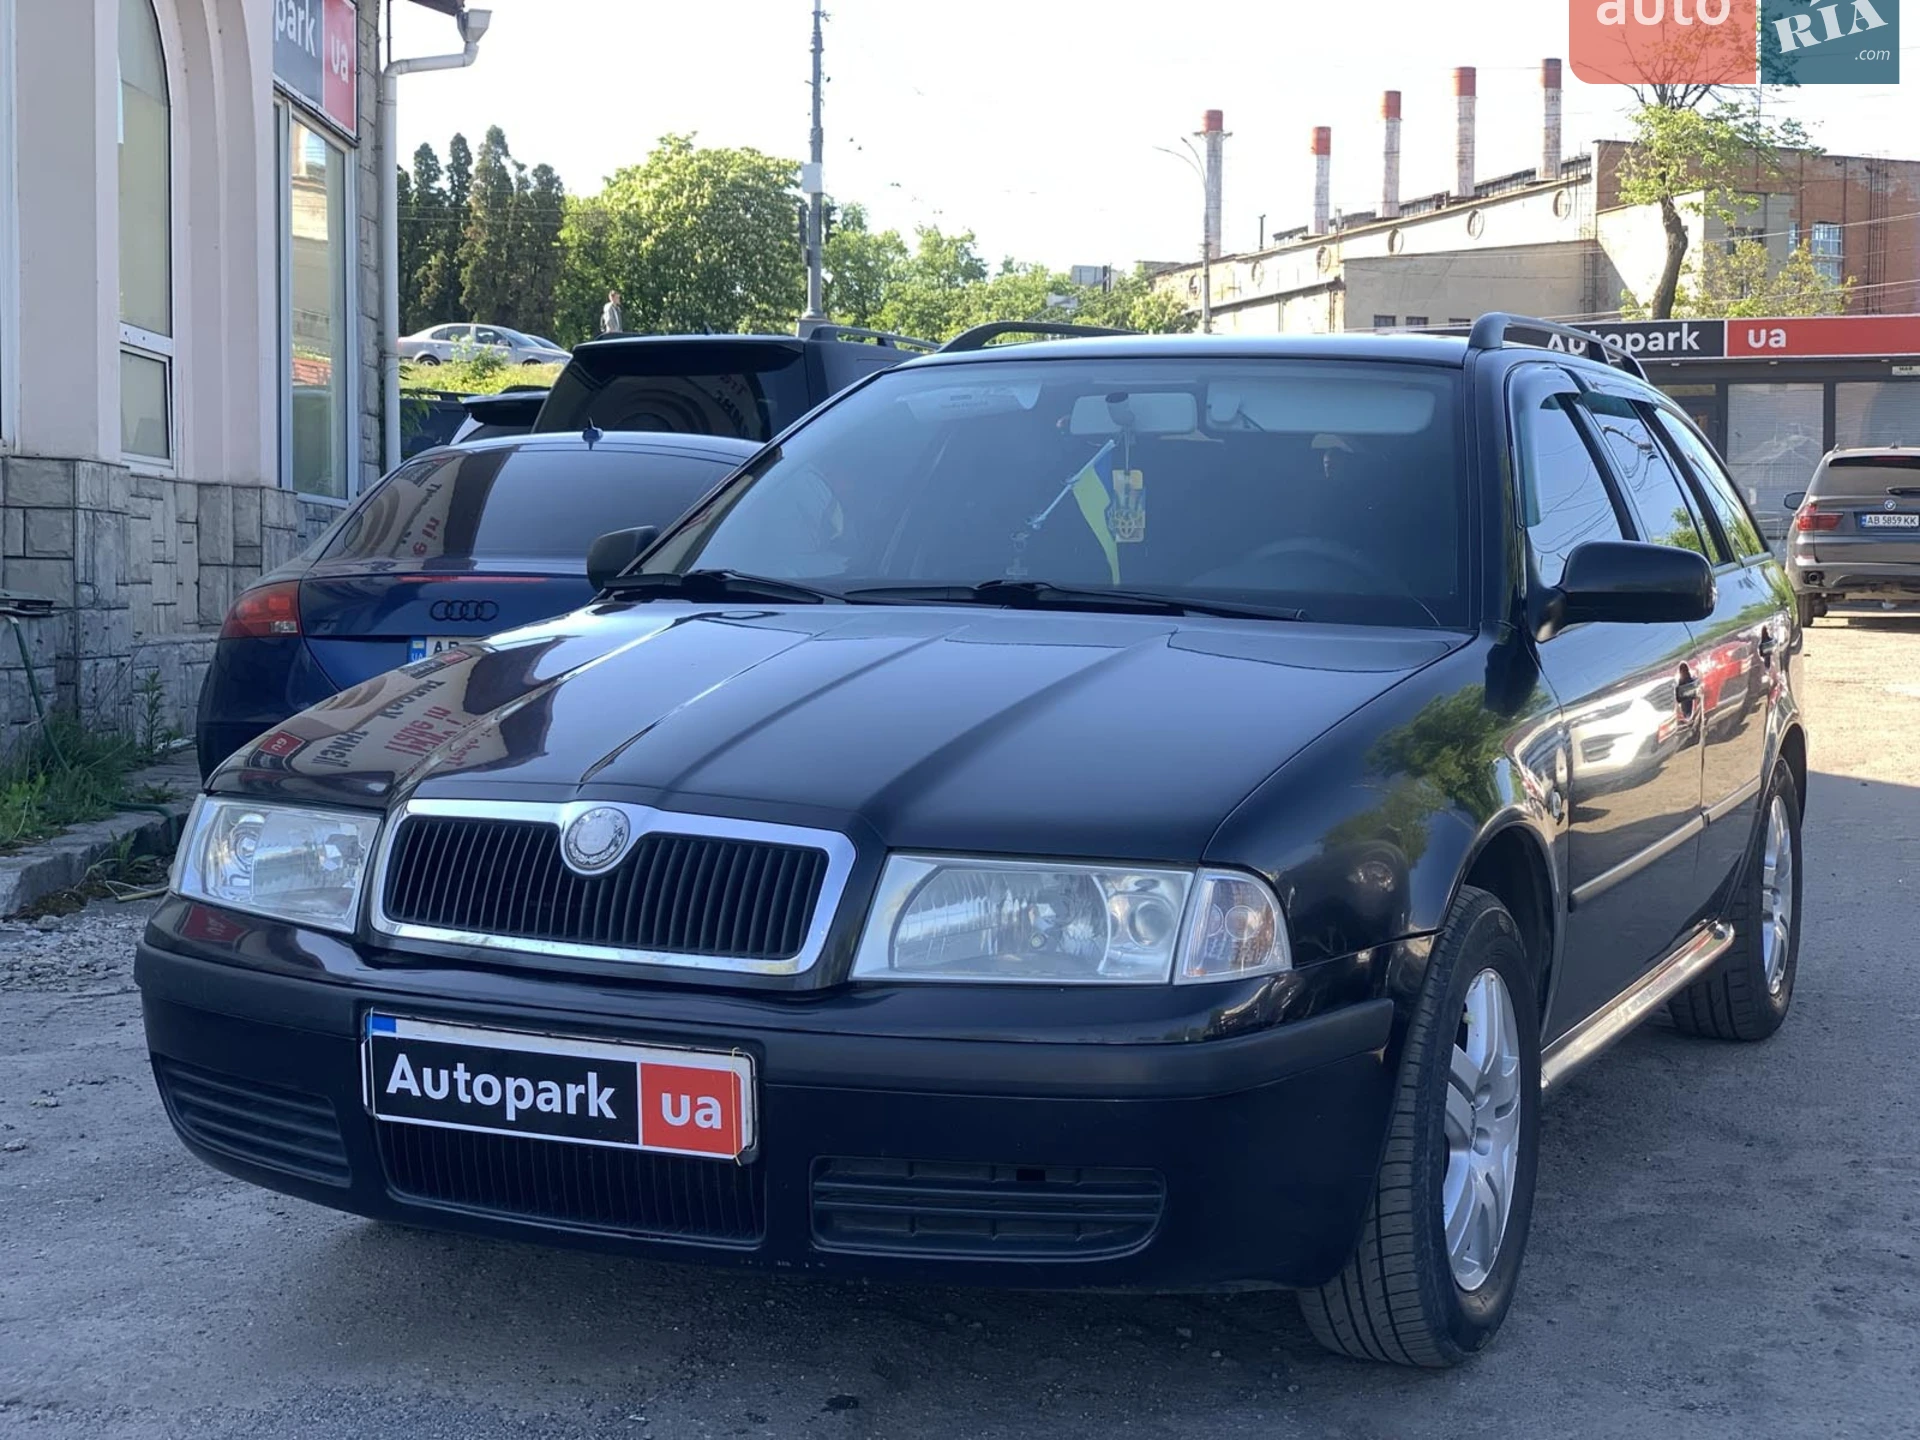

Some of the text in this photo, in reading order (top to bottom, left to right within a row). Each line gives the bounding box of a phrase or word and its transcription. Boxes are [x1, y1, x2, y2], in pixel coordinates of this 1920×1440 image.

[331, 31, 350, 85] ua
[1747, 327, 1787, 349] ua
[1882, 515, 1902, 525] 5859
[1903, 516, 1918, 525] KK
[385, 1053, 722, 1130] Autopark ua
